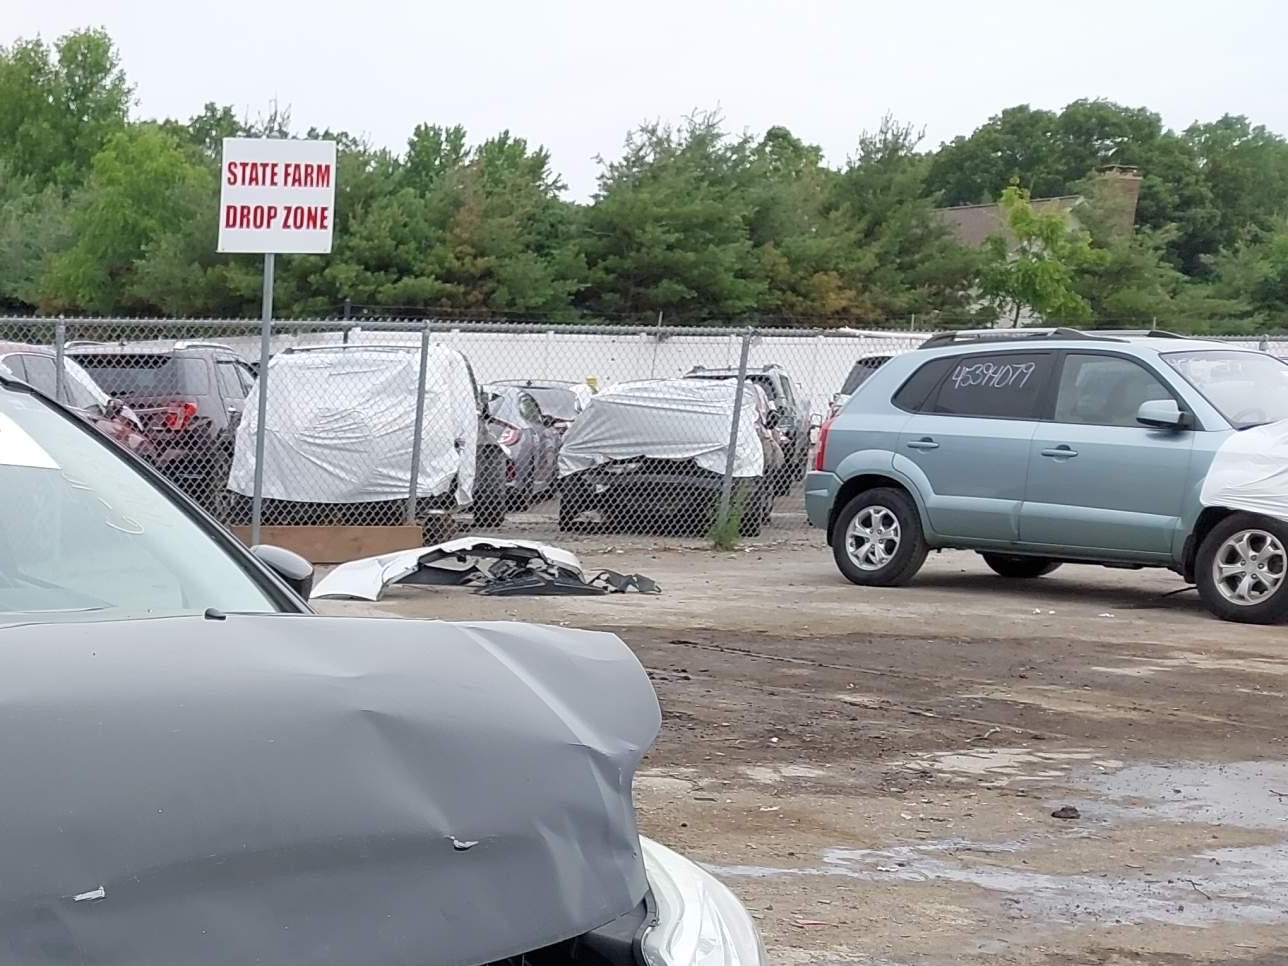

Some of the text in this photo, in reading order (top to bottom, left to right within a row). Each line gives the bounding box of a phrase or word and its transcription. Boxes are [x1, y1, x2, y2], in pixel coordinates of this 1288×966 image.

[227, 161, 330, 187] STATE FARM
[225, 205, 328, 230] DROP ZONE
[952, 362, 1036, 389] 45394079
